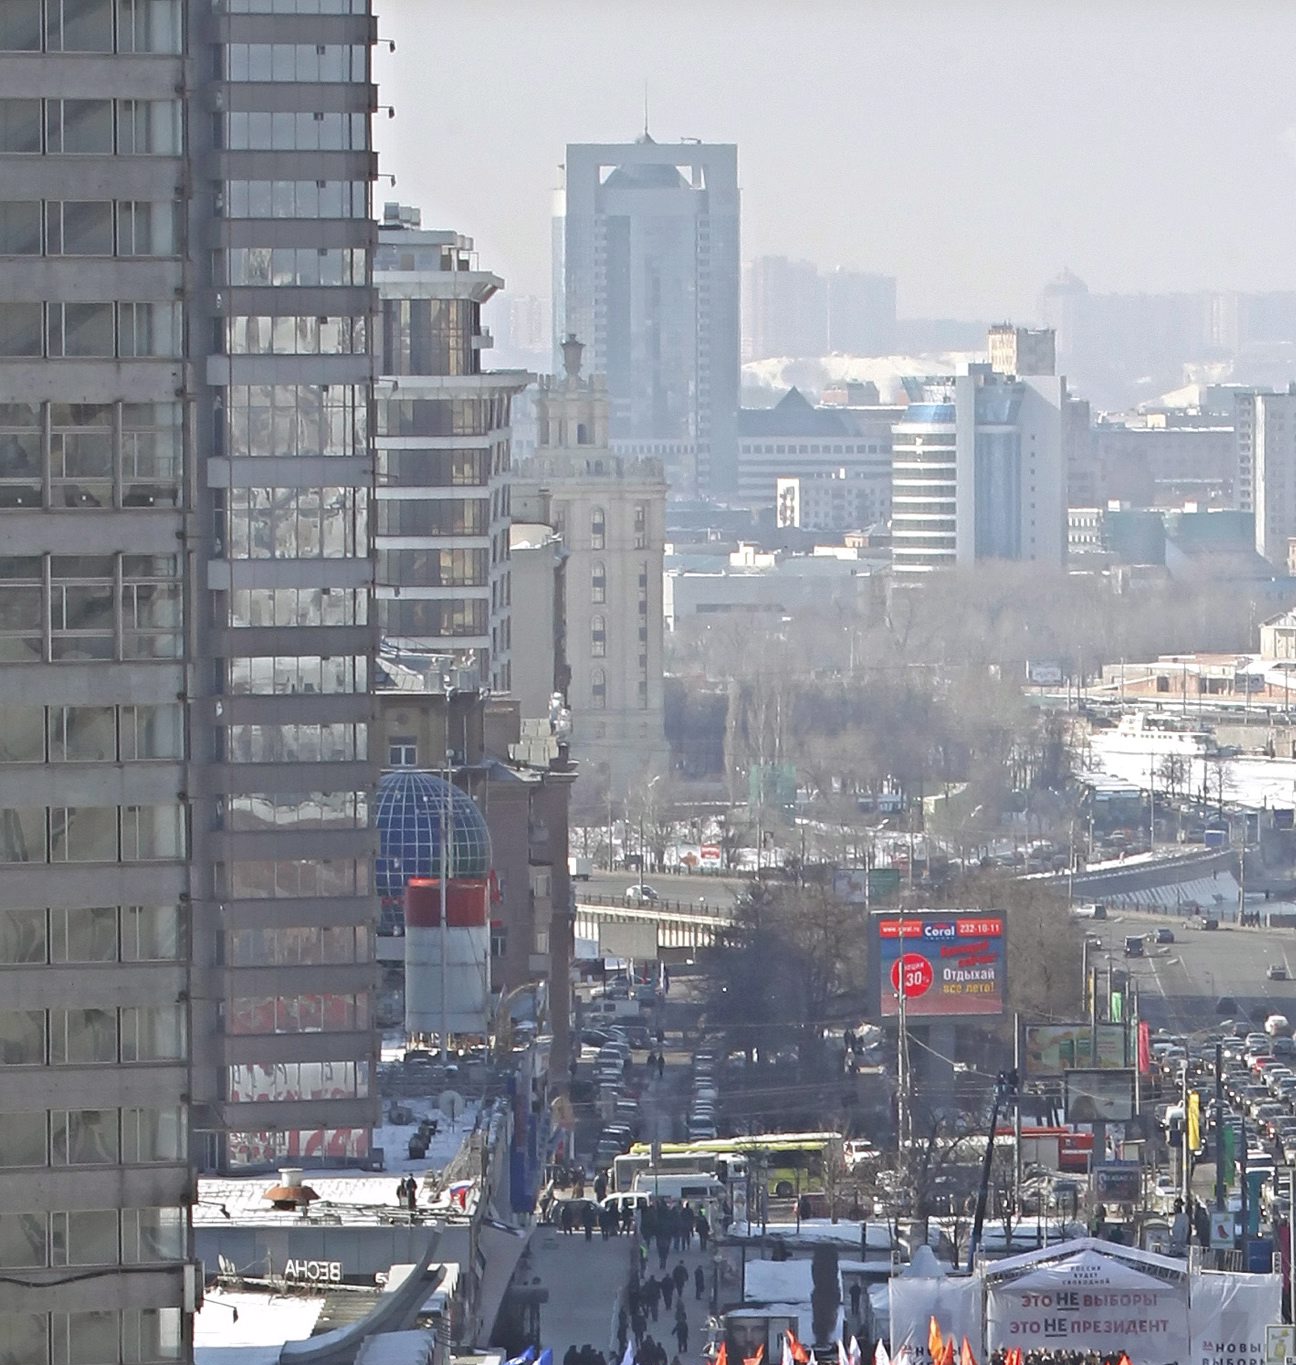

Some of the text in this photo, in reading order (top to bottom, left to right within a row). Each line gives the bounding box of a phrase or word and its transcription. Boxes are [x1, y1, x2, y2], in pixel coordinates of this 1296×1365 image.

[924, 926, 955, 936] Coral
[943, 968, 995, 982] Отдыхай
[1021, 1292, 1158, 1308] ЭТО НЕ ВЫБОРЫ
[1010, 1318, 1169, 1335] ЭТО НЕ ПРЕЗИДЕНТ
[1216, 1343, 1261, 1353] НОВЫ
